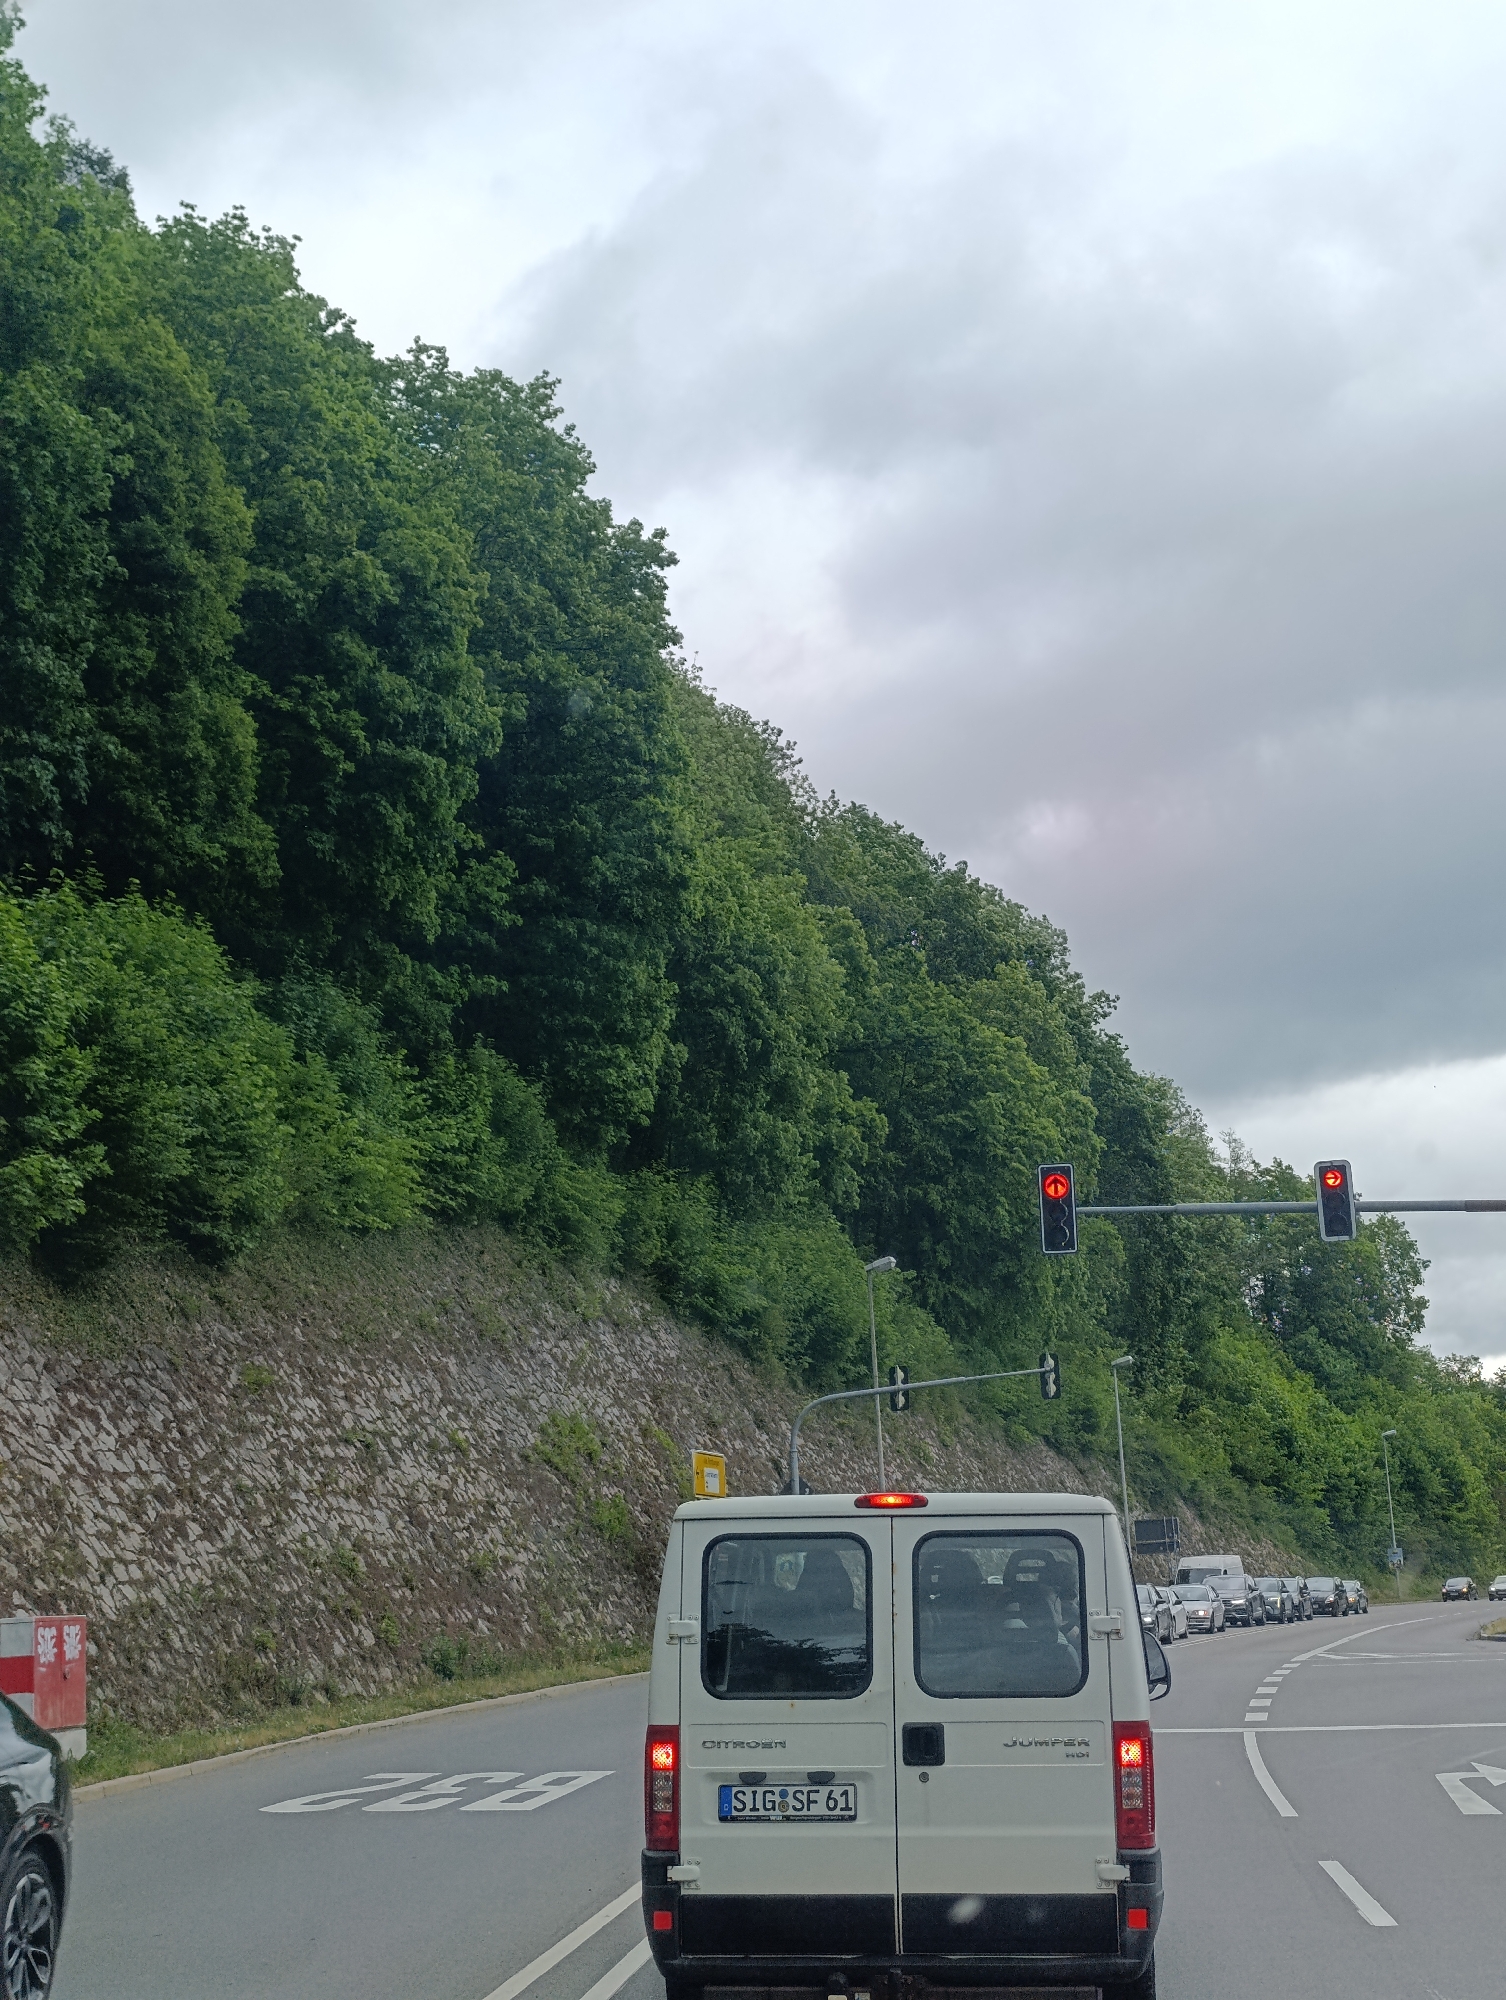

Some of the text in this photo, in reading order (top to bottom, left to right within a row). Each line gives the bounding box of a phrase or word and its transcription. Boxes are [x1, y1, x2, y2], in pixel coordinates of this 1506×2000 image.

[702, 1738, 787, 1749] CITROËN
[1003, 1737, 1090, 1748] JUMPER
[733, 1789, 852, 1812] SIG SF 61
[723, 1803, 730, 1811] D
